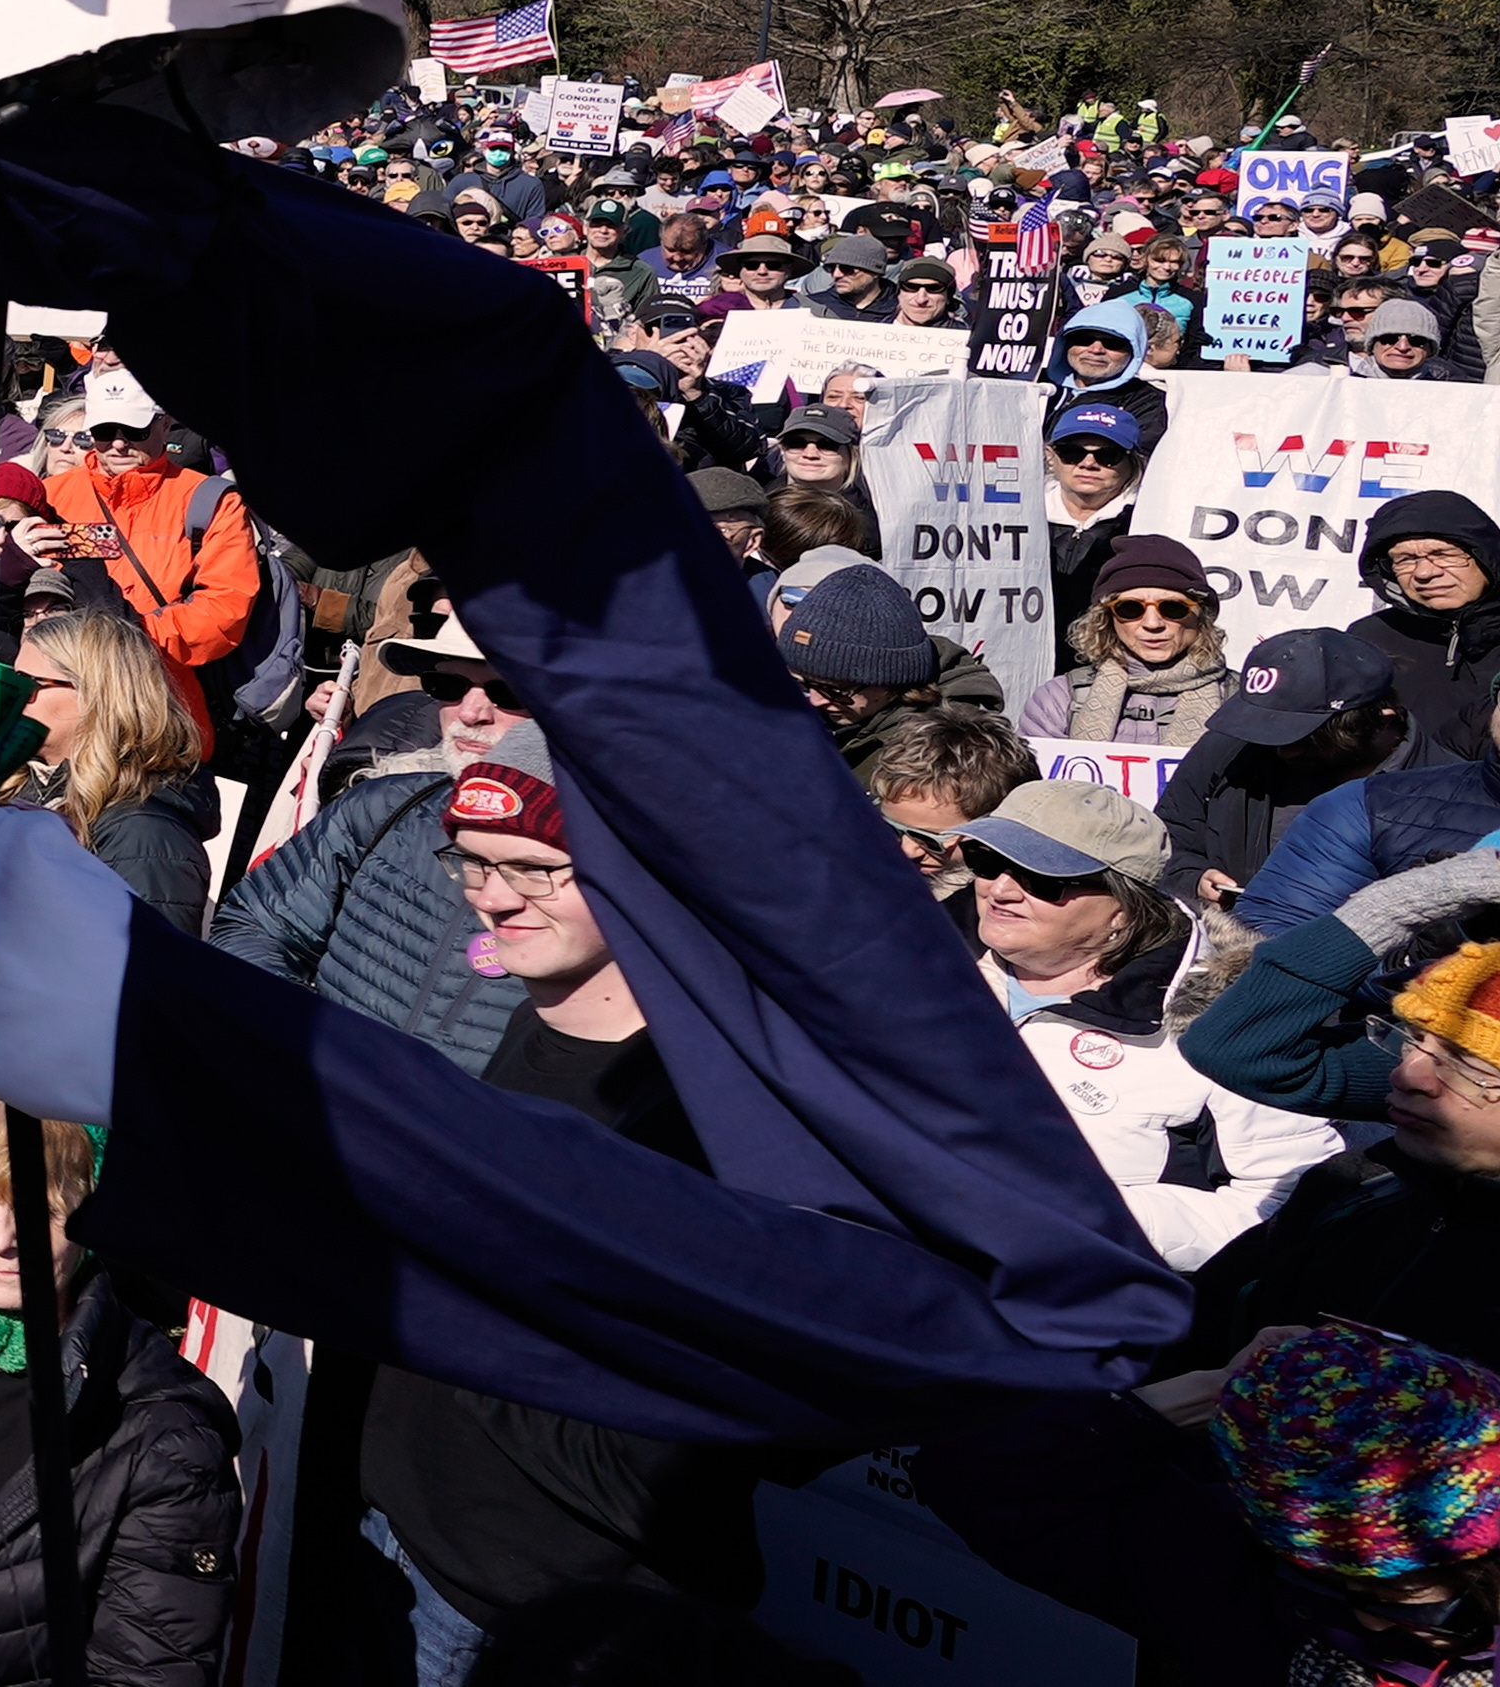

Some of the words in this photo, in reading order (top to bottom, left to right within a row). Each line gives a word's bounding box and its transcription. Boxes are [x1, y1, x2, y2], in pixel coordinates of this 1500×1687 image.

[558, 94, 617, 105] CONGRESS
[577, 86, 601, 95] GOP
[555, 111, 615, 122] COMPLICIT
[573, 103, 601, 113] 100%
[1246, 158, 1343, 194] OMG
[1227, 249, 1243, 260] IN
[1252, 247, 1290, 260] USA
[1243, 269, 1304, 285] PEOPLE
[988, 282, 1049, 310] MUST
[1231, 290, 1289, 306] REIGN
[997, 313, 1030, 342] GO
[825, 341, 908, 362] BOUNDARIES
[918, 352, 938, 365] OF
[977, 344, 1037, 373] NOW!
[913, 443, 1021, 503] WE
[1233, 431, 1429, 498] WE
[912, 524, 1029, 561] DON'T
[1188, 505, 1359, 554] DON
[1200, 565, 1329, 612] OW
[904, 587, 986, 623] OW
[1000, 587, 1044, 624] TO
[1067, 1082, 1104, 1111] PRESIDENT
[812, 1555, 968, 1662] IDIOT
